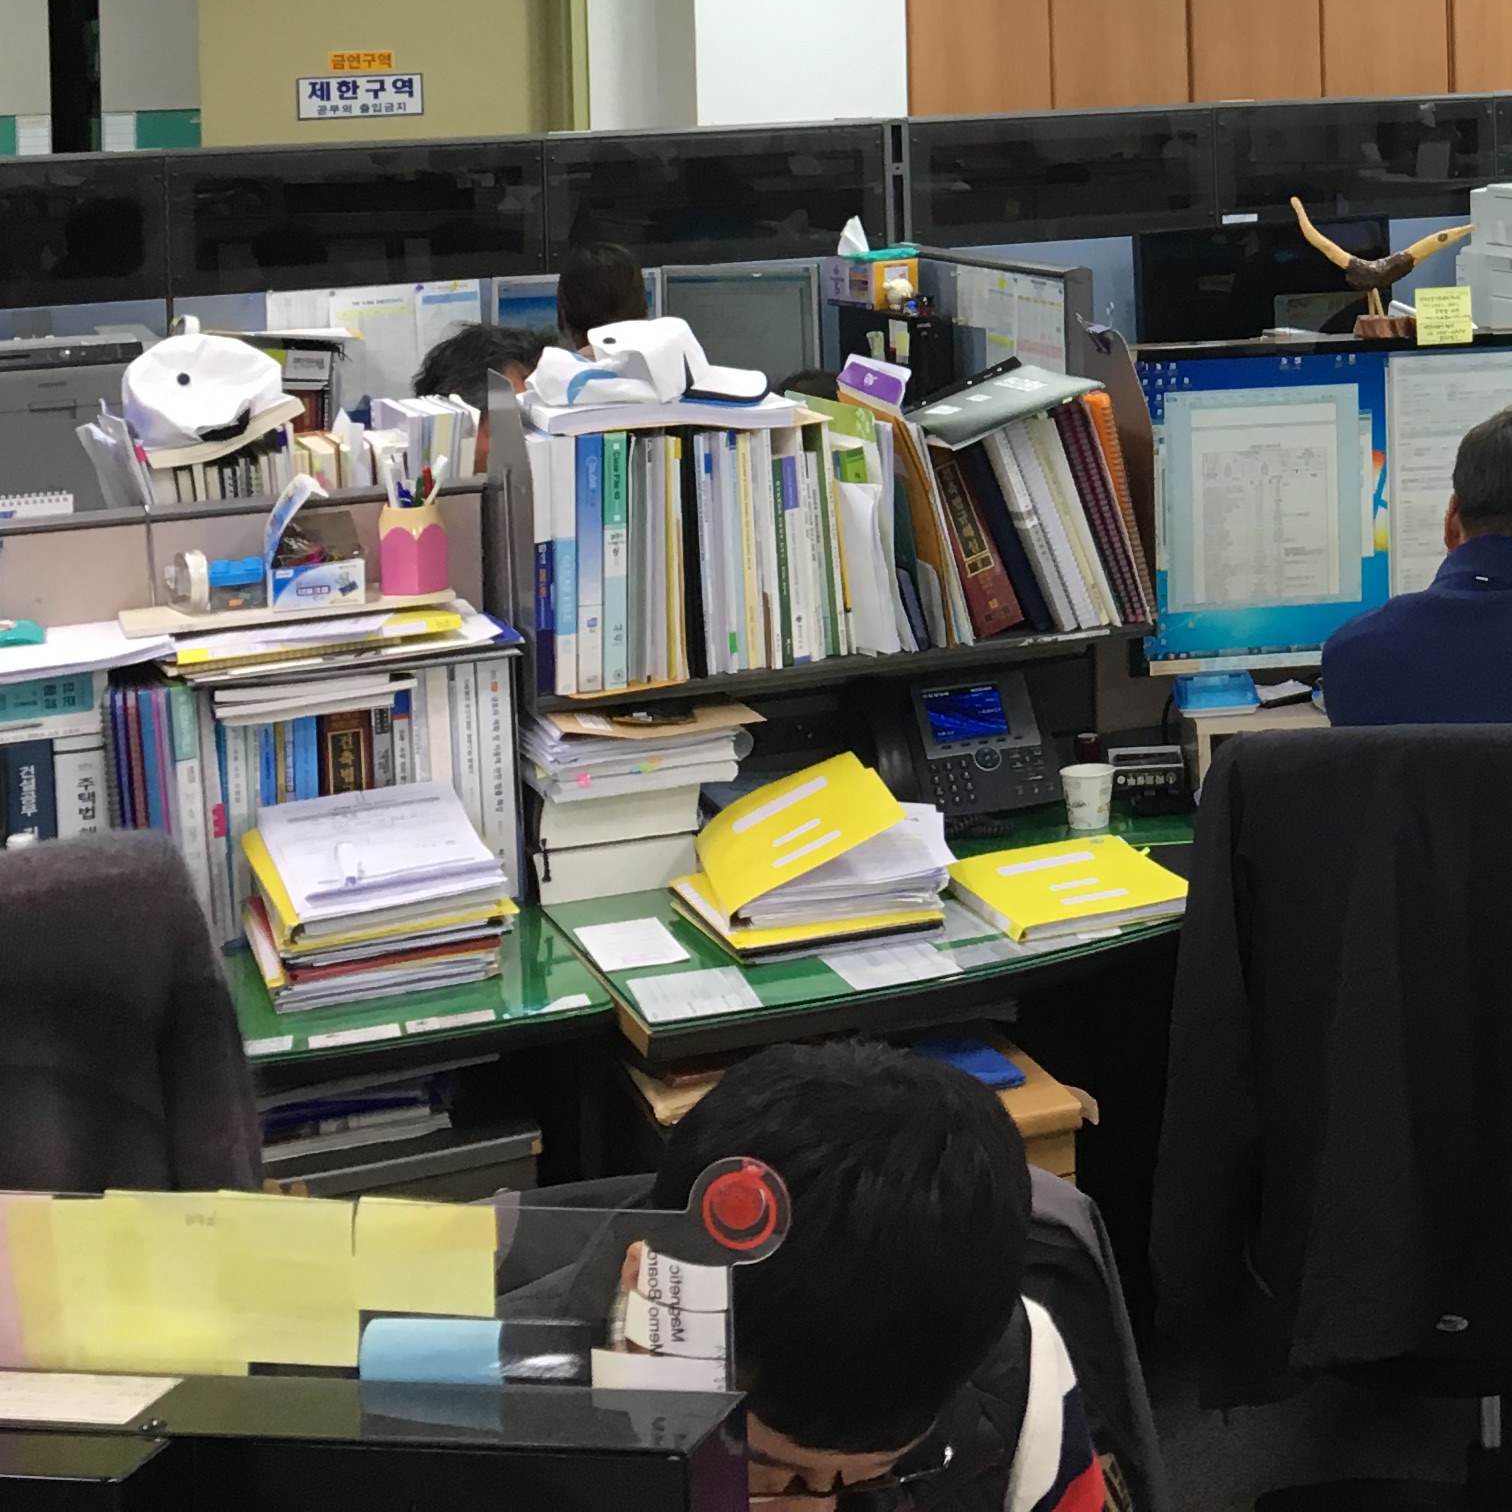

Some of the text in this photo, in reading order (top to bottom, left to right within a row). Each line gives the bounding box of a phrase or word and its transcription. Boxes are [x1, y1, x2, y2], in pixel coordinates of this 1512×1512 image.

[331, 52, 393, 71] 금연구역
[307, 77, 414, 102] 제한구역
[77, 777, 96, 820] 주택법
